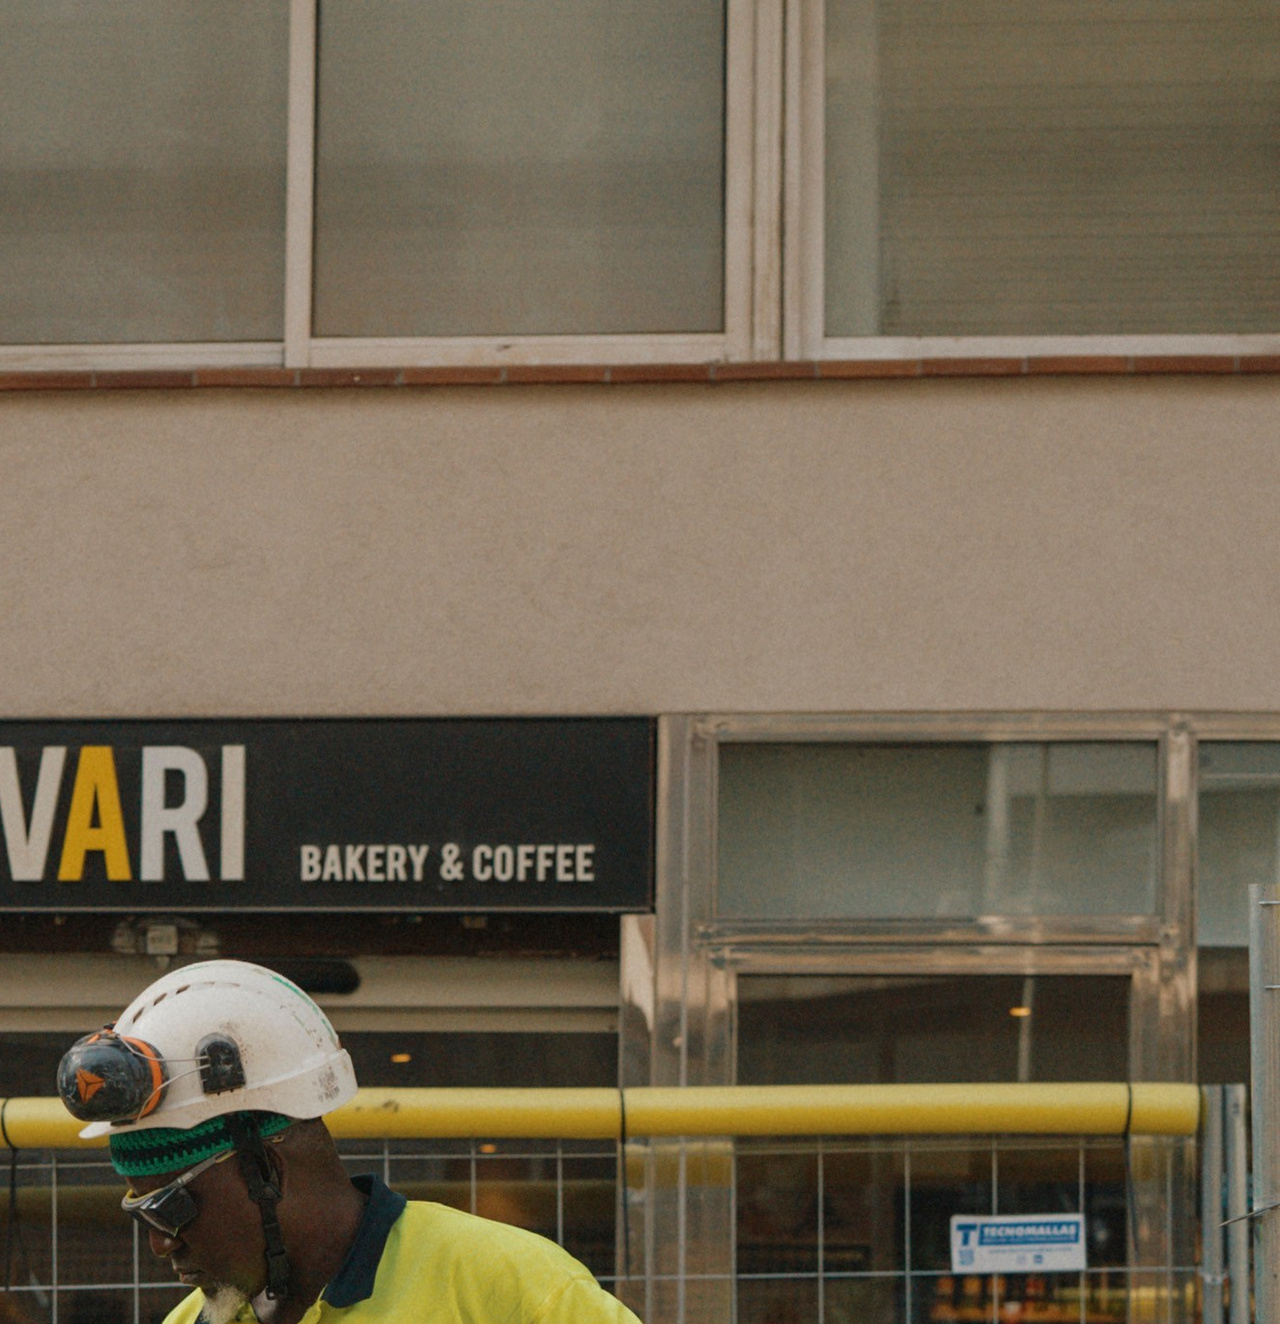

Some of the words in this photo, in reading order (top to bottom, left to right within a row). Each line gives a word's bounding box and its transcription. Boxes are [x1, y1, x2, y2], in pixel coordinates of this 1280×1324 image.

[300, 844, 429, 882] BAKERY
[440, 842, 464, 881] &
[472, 844, 595, 882] COFFEE
